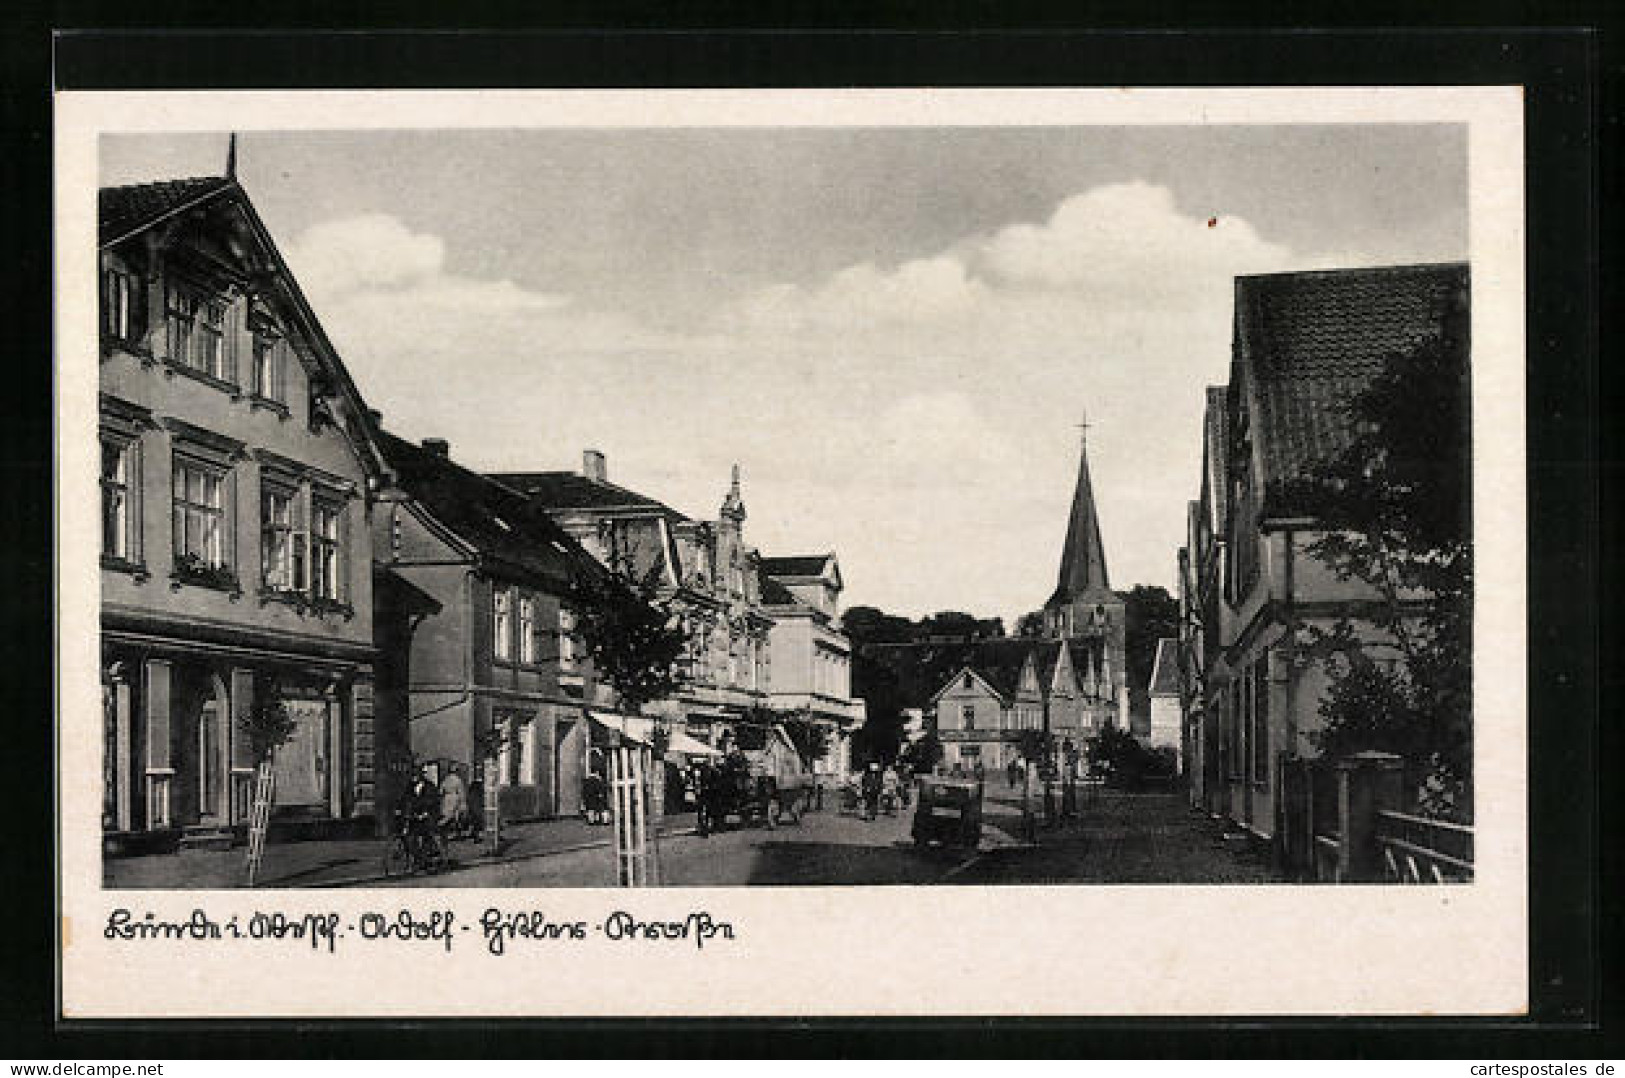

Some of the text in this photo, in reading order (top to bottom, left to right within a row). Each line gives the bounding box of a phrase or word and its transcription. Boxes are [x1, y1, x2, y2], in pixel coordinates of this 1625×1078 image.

[103, 908, 222, 940] Bünde
[359, 908, 454, 952] Adolf
[478, 908, 587, 957] Hitler
